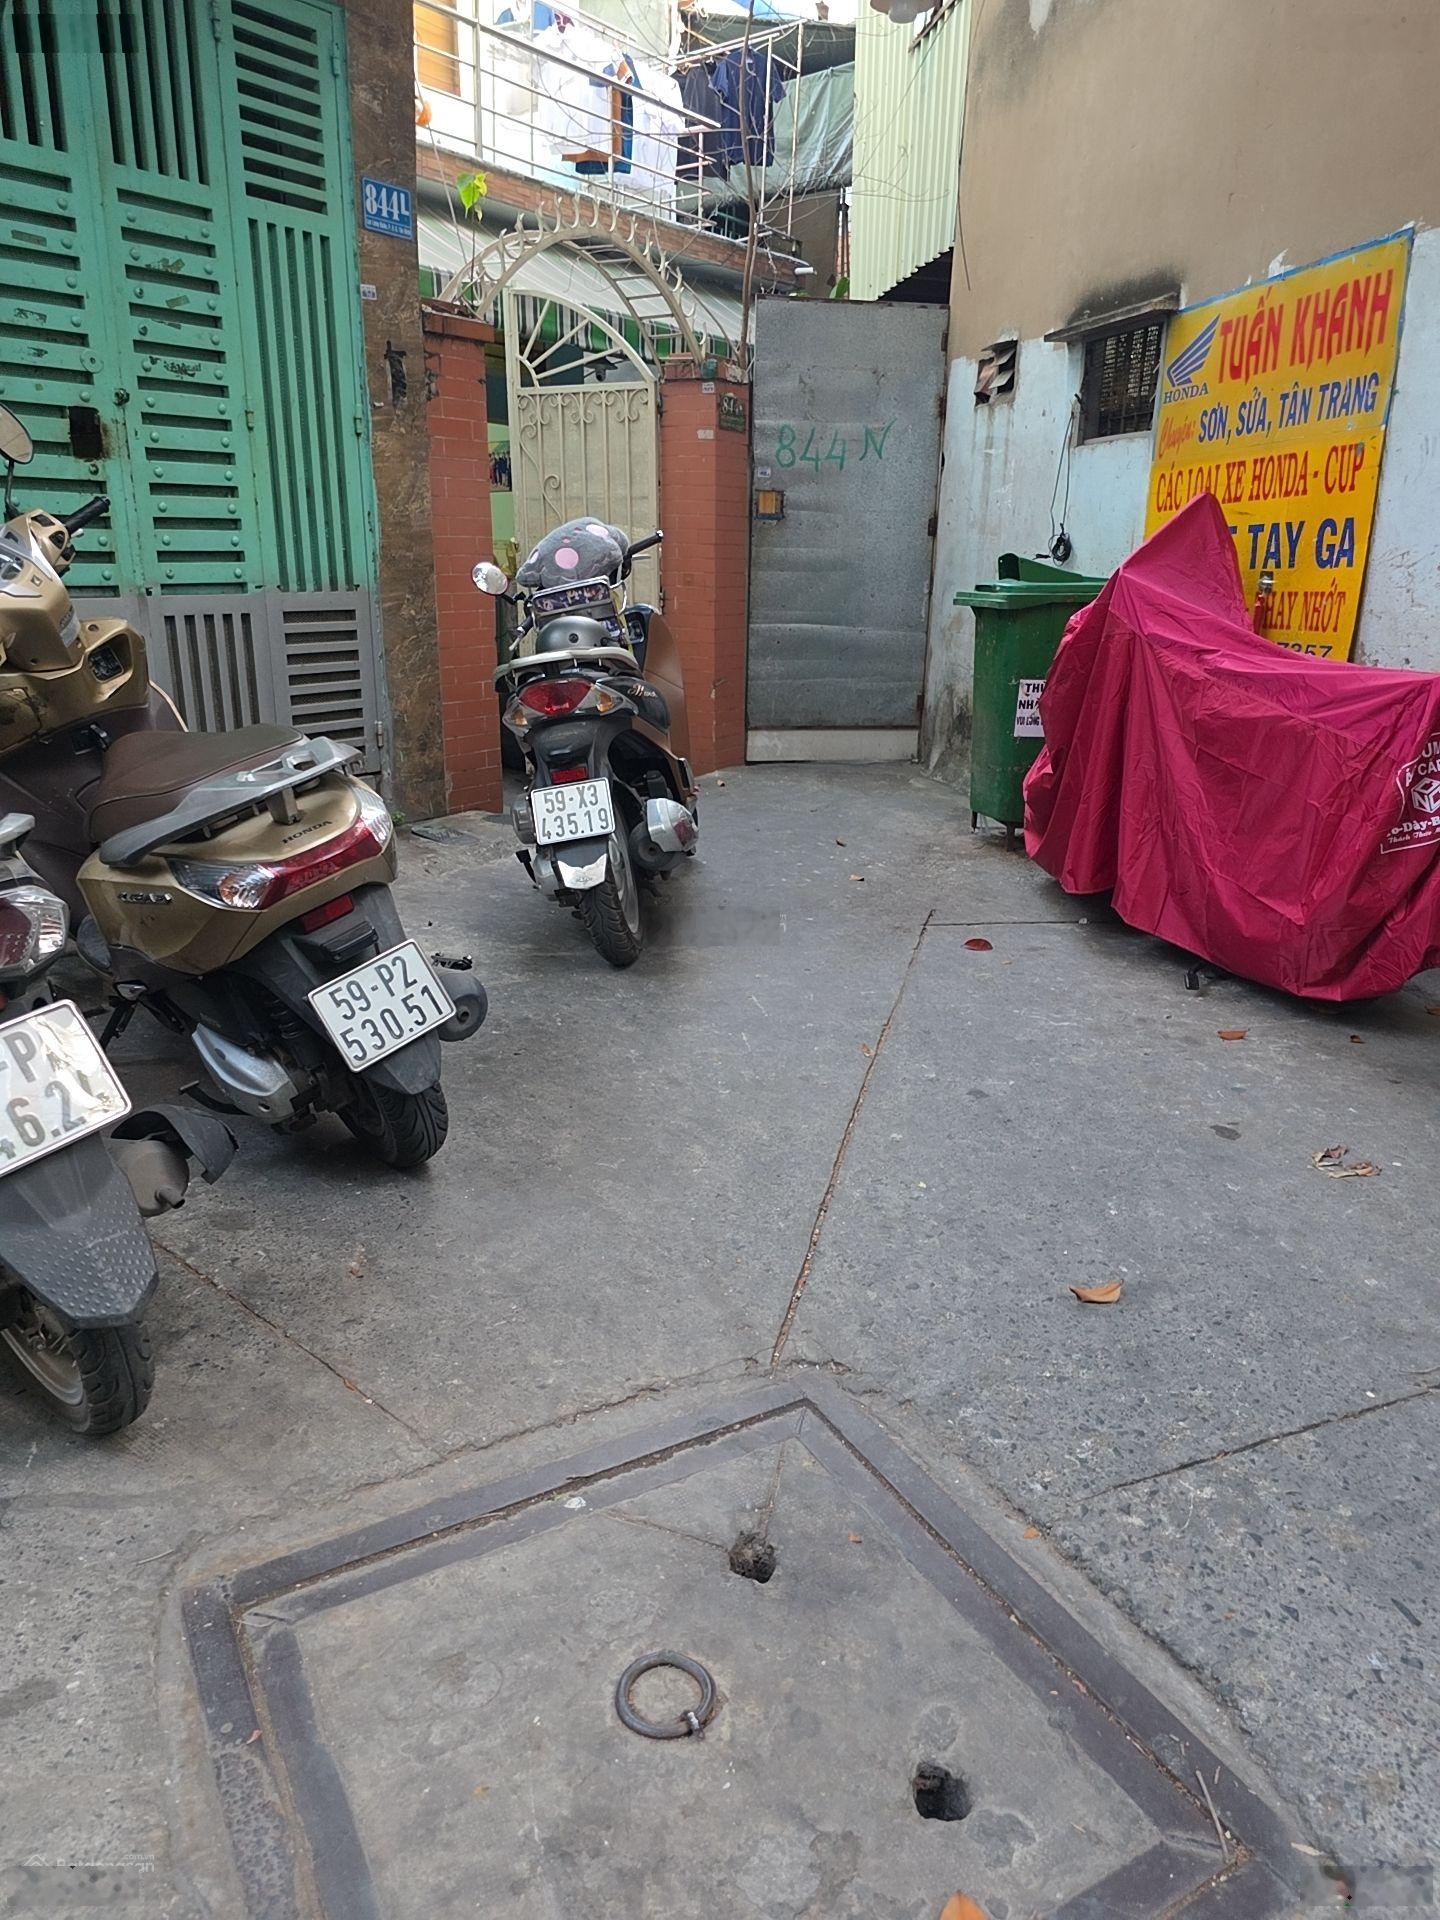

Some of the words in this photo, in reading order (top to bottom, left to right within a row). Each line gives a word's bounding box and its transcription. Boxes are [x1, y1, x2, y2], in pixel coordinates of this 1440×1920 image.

[365, 184, 410, 221] 844L
[1218, 285, 1284, 386] TUẤN
[1289, 269, 1393, 372] KHANH
[1163, 382, 1209, 405] HONDA
[1198, 402, 1232, 446] SƠN,
[1236, 386, 1272, 439] SỬA,
[1279, 381, 1313, 429] TÂN
[1317, 371, 1380, 421] TRANG
[1157, 461, 1184, 512] CÁC
[1222, 460, 1247, 504] XE
[1248, 451, 1309, 501] HONDA
[1324, 442, 1366, 494] CUP
[1248, 521, 1305, 570] TAY
[1315, 517, 1355, 569] GA
[1257, 591, 1298, 630] HAY
[1298, 576, 1346, 633] NHỚT
[541, 807, 609, 839] 435.19
[543, 784, 599, 814] 59-X3
[282, 820, 333, 844] HONDA
[328, 956, 418, 1021] 59-P2
[340, 985, 443, 1062] 530.51
